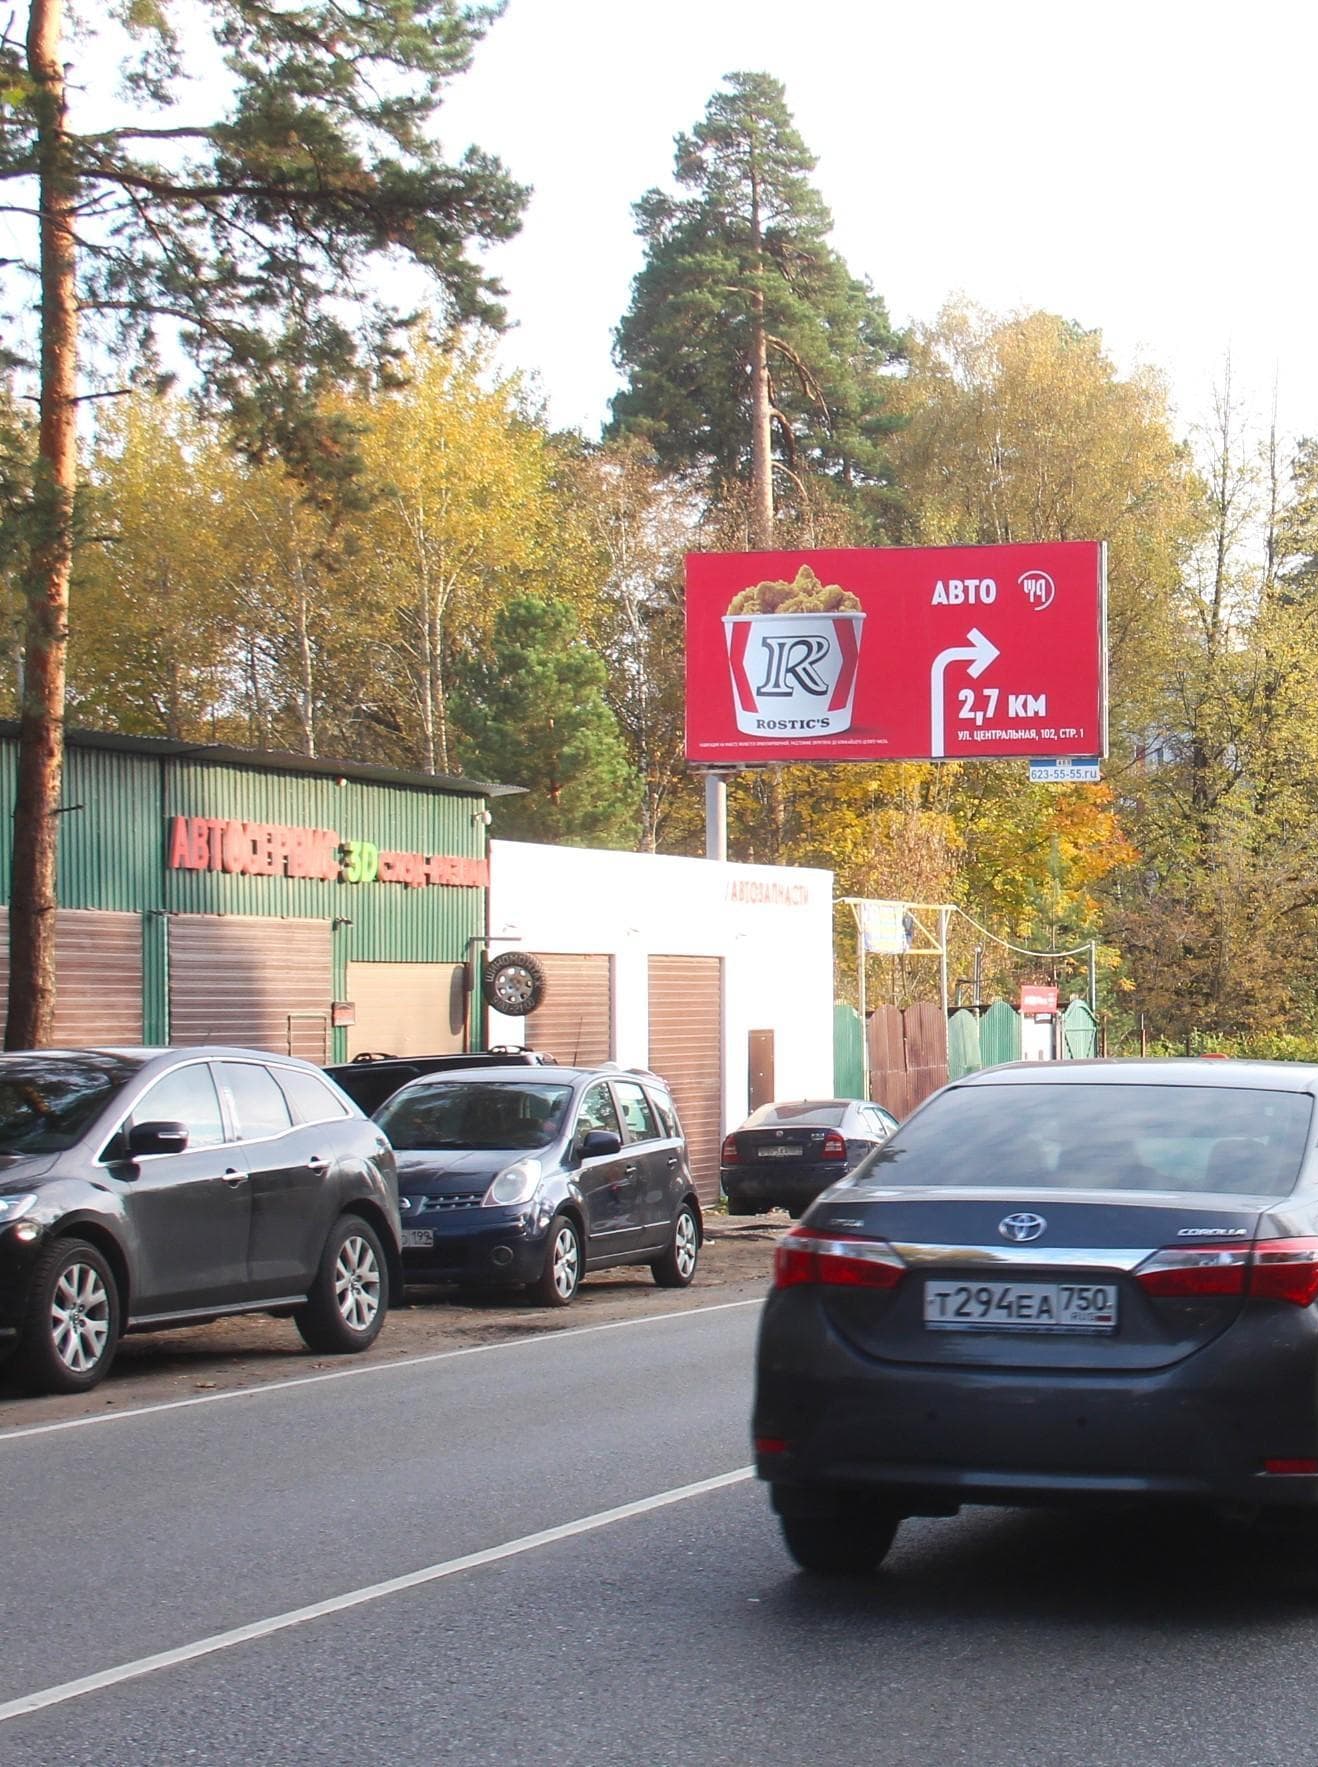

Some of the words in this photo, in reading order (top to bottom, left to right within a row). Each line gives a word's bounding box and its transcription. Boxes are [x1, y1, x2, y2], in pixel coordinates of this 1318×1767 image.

[931, 578, 997, 605] АВТО
[756, 634, 830, 697] R
[958, 688, 999, 726] 2,7
[756, 717, 830, 730] ROSTIC'S
[958, 730, 972, 741] УЛ.
[974, 729, 1039, 742] ЦЕНТРАЛЬНАЯ,
[1041, 729, 1058, 740] 102,
[1059, 728, 1078, 739] СТР.
[1080, 728, 1084, 738] 1
[1031, 767, 1098, 780] 623-55-55.ru
[170, 815, 341, 881] АВТОСЕРВИС
[343, 840, 379, 883] 3D
[1177, 1228, 1247, 1236] COROLLA
[934, 1286, 1053, 1319] Т294ЕА
[1061, 1287, 1107, 1311] 750
